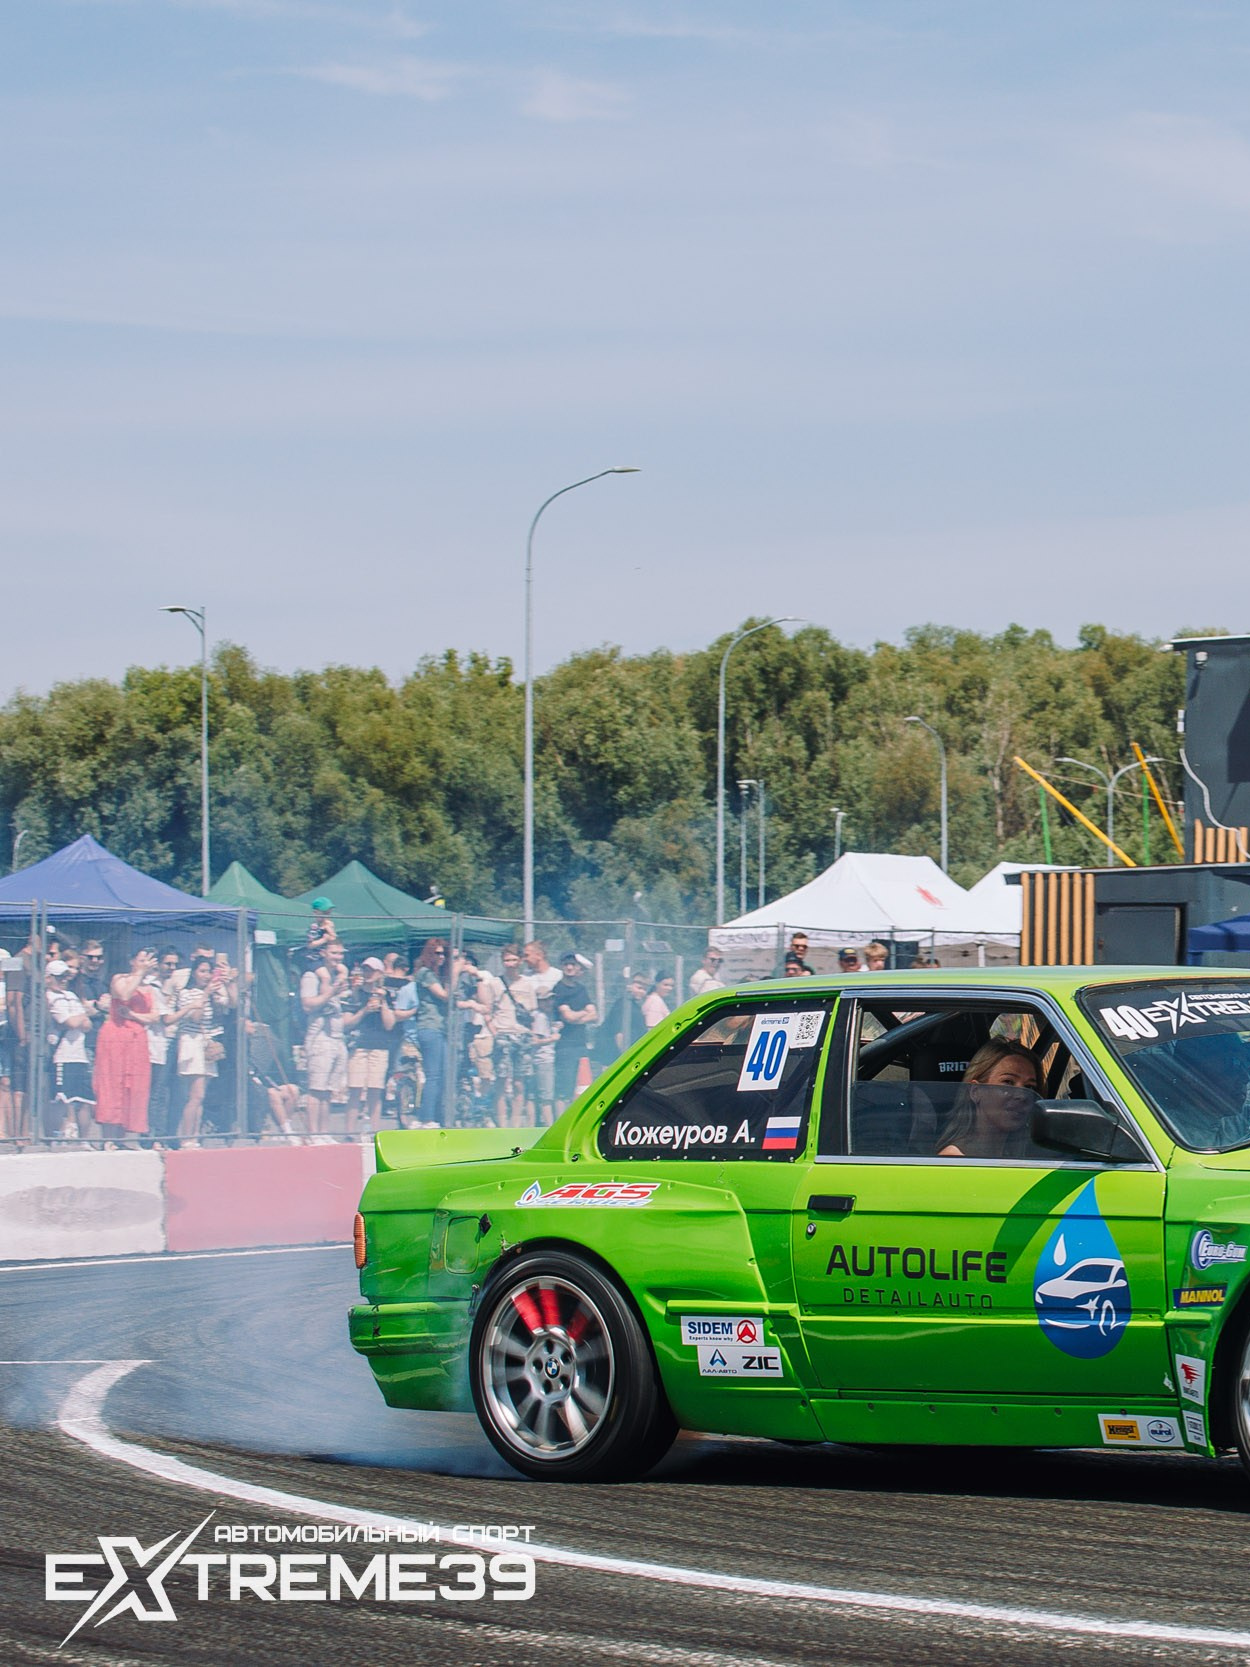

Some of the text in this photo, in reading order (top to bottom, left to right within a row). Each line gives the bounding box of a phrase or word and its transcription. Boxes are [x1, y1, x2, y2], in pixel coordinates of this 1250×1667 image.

[1099, 1005, 1160, 1041] 40
[746, 1030, 788, 1082] 40
[938, 1061, 970, 1073] BRID
[614, 1119, 756, 1149] Кожеуров А.
[540, 1183, 660, 1199] AGS
[825, 1244, 1008, 1284] AUTOLIFE
[843, 1287, 993, 1309] DETAILAUTO
[1180, 1289, 1225, 1303] MANNOL
[688, 1321, 733, 1335] SIDEM
[742, 1355, 780, 1371] ZIC
